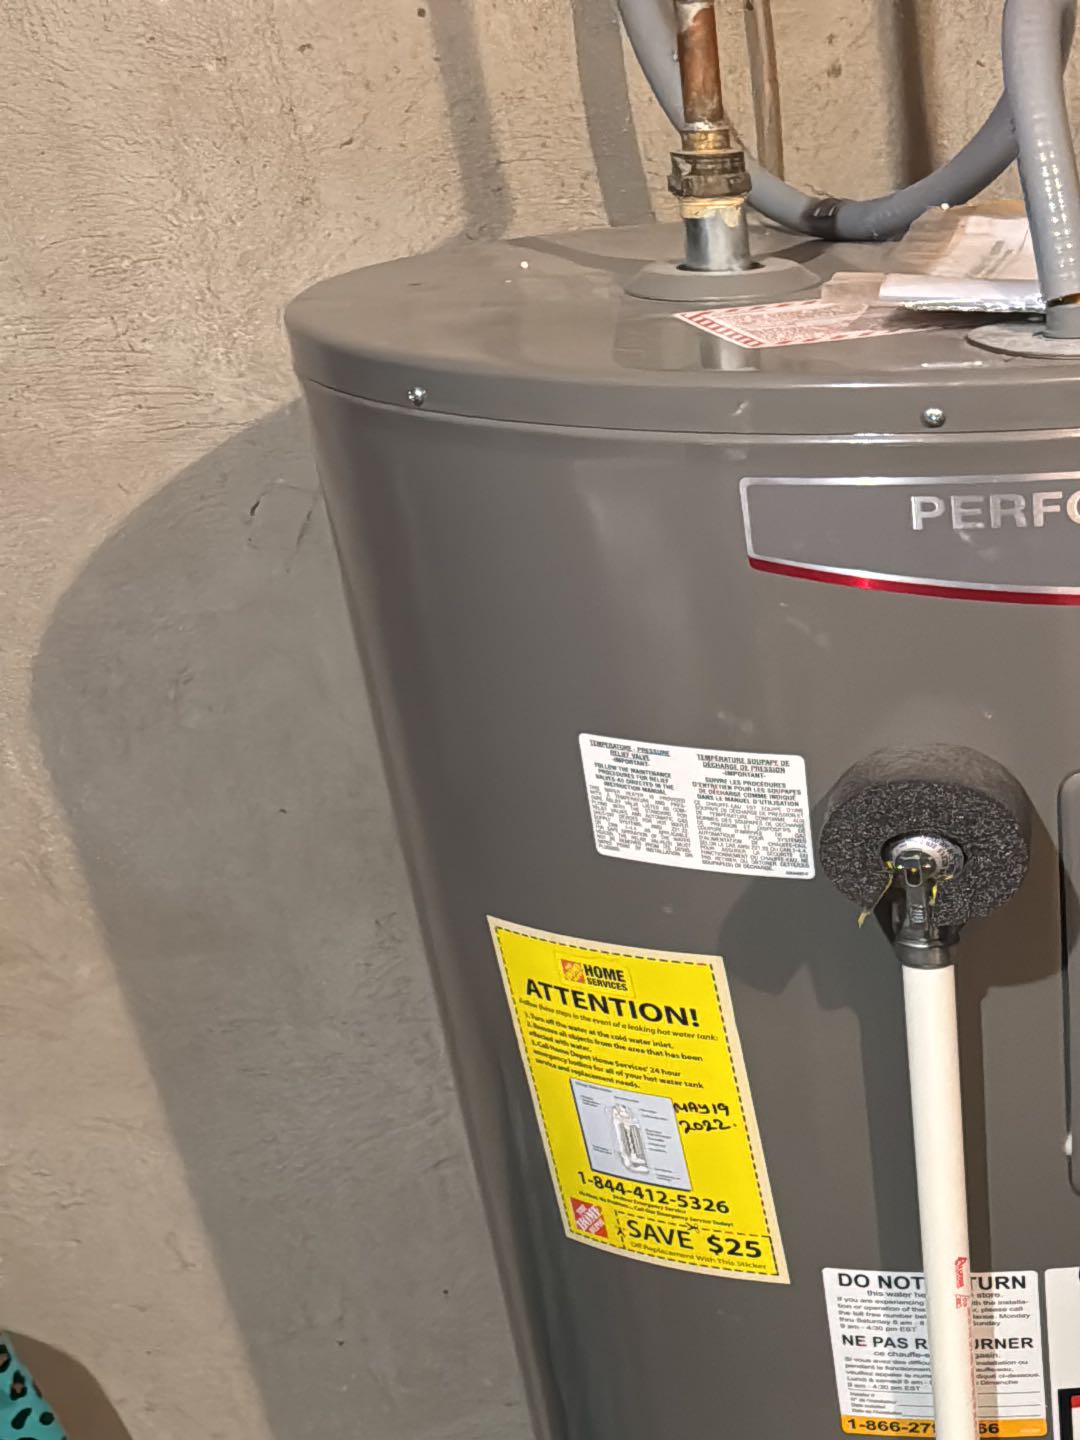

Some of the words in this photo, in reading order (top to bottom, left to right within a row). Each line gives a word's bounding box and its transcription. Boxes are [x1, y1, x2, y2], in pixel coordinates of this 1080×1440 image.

[583, 963, 626, 983] HOME
[586, 977, 628, 992] SERVICES
[526, 977, 700, 1028] ATTENTION!
[592, 1018, 612, 1027] event
[627, 1022, 656, 1035] leaking
[656, 1027, 671, 1036] hot
[672, 1031, 695, 1039] water
[596, 1030, 610, 1039] the
[610, 1034, 628, 1042] cold
[628, 1037, 651, 1046] water
[594, 1039, 613, 1049] from
[613, 1042, 627, 1051] the
[627, 1046, 646, 1054] area
[646, 1048, 664, 1058] that
[664, 1051, 680, 1060] has
[680, 1053, 704, 1062] been
[592, 1055, 614, 1066] Home
[649, 1066, 661, 1074] 24
[661, 1068, 681, 1077] hour
[624, 1072, 643, 1082] your
[643, 1074, 658, 1083] hot
[659, 1078, 683, 1087] water
[683, 1080, 705, 1089] tank
[673, 1101, 711, 1115] MAY
[711, 1102, 730, 1117] 19
[577, 1170, 730, 1214] 1-844-412-5326
[626, 1219, 695, 1250] SAVE
[706, 1233, 762, 1259] $25
[695, 1255, 717, 1264] With
[736, 1260, 767, 1270] Sticker
[837, 1272, 870, 1289] DO
[877, 1274, 925, 1290] NOT
[866, 1289, 884, 1297] this
[884, 1291, 912, 1299] water
[838, 1309, 851, 1317] the
[841, 1334, 867, 1347] NE
[872, 1336, 909, 1350] PAS
